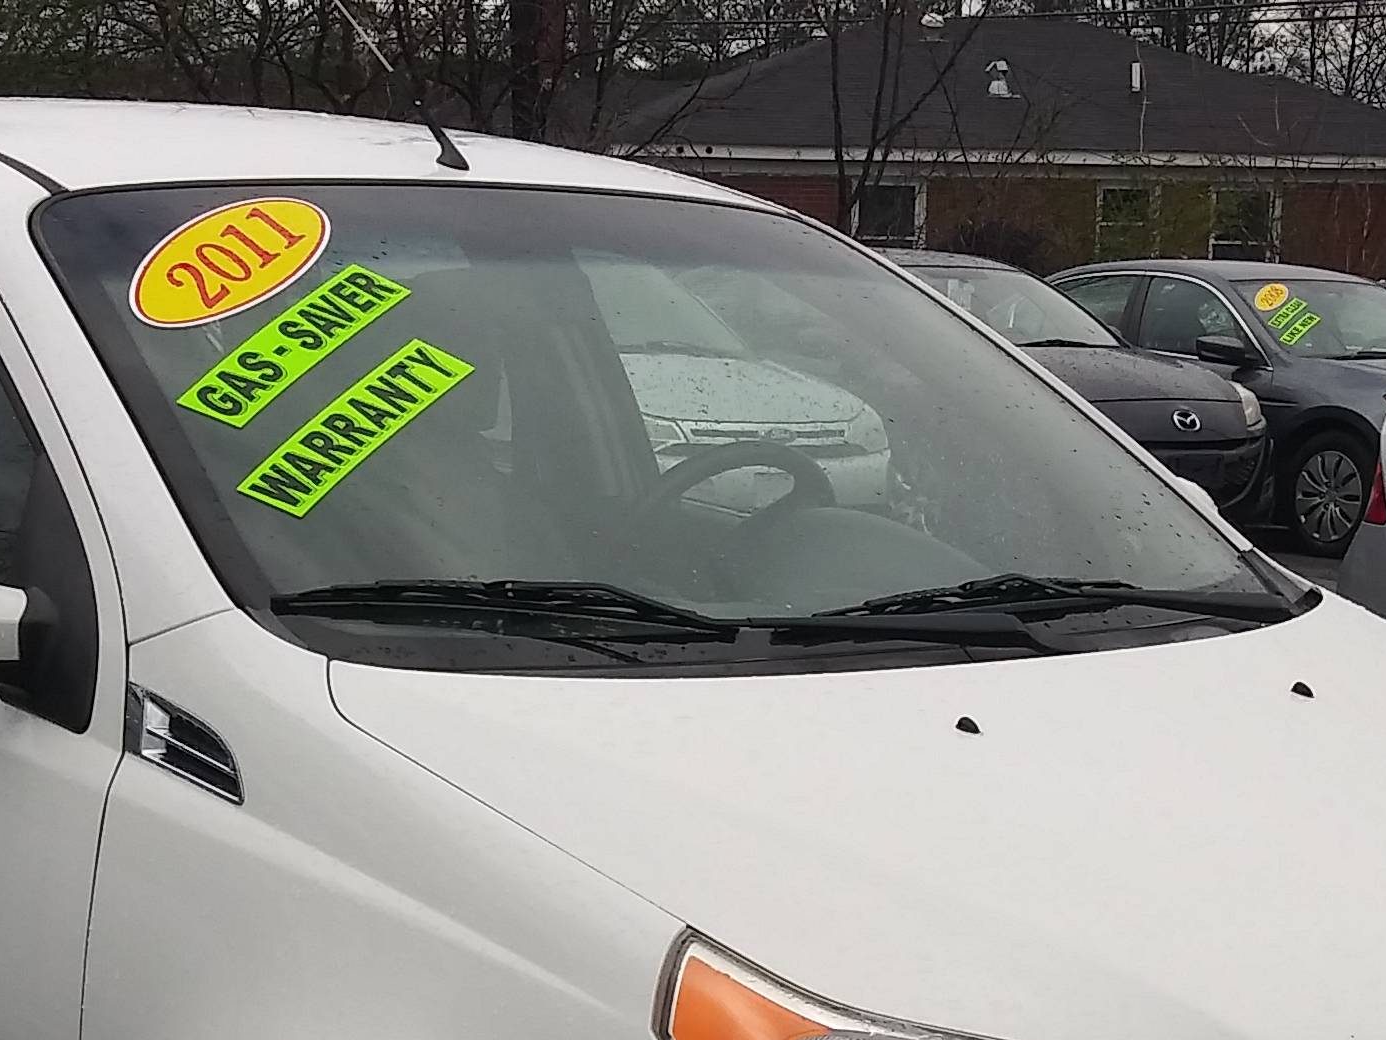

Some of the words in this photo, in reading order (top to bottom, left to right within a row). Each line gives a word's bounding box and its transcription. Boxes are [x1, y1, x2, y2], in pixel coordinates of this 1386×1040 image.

[166, 207, 306, 309] 2011
[196, 350, 288, 418] GAS
[277, 269, 397, 352] SAVER
[1282, 327, 1303, 343] LIKE
[1299, 314, 1317, 329] NEW
[249, 346, 458, 507] WARRANTY
